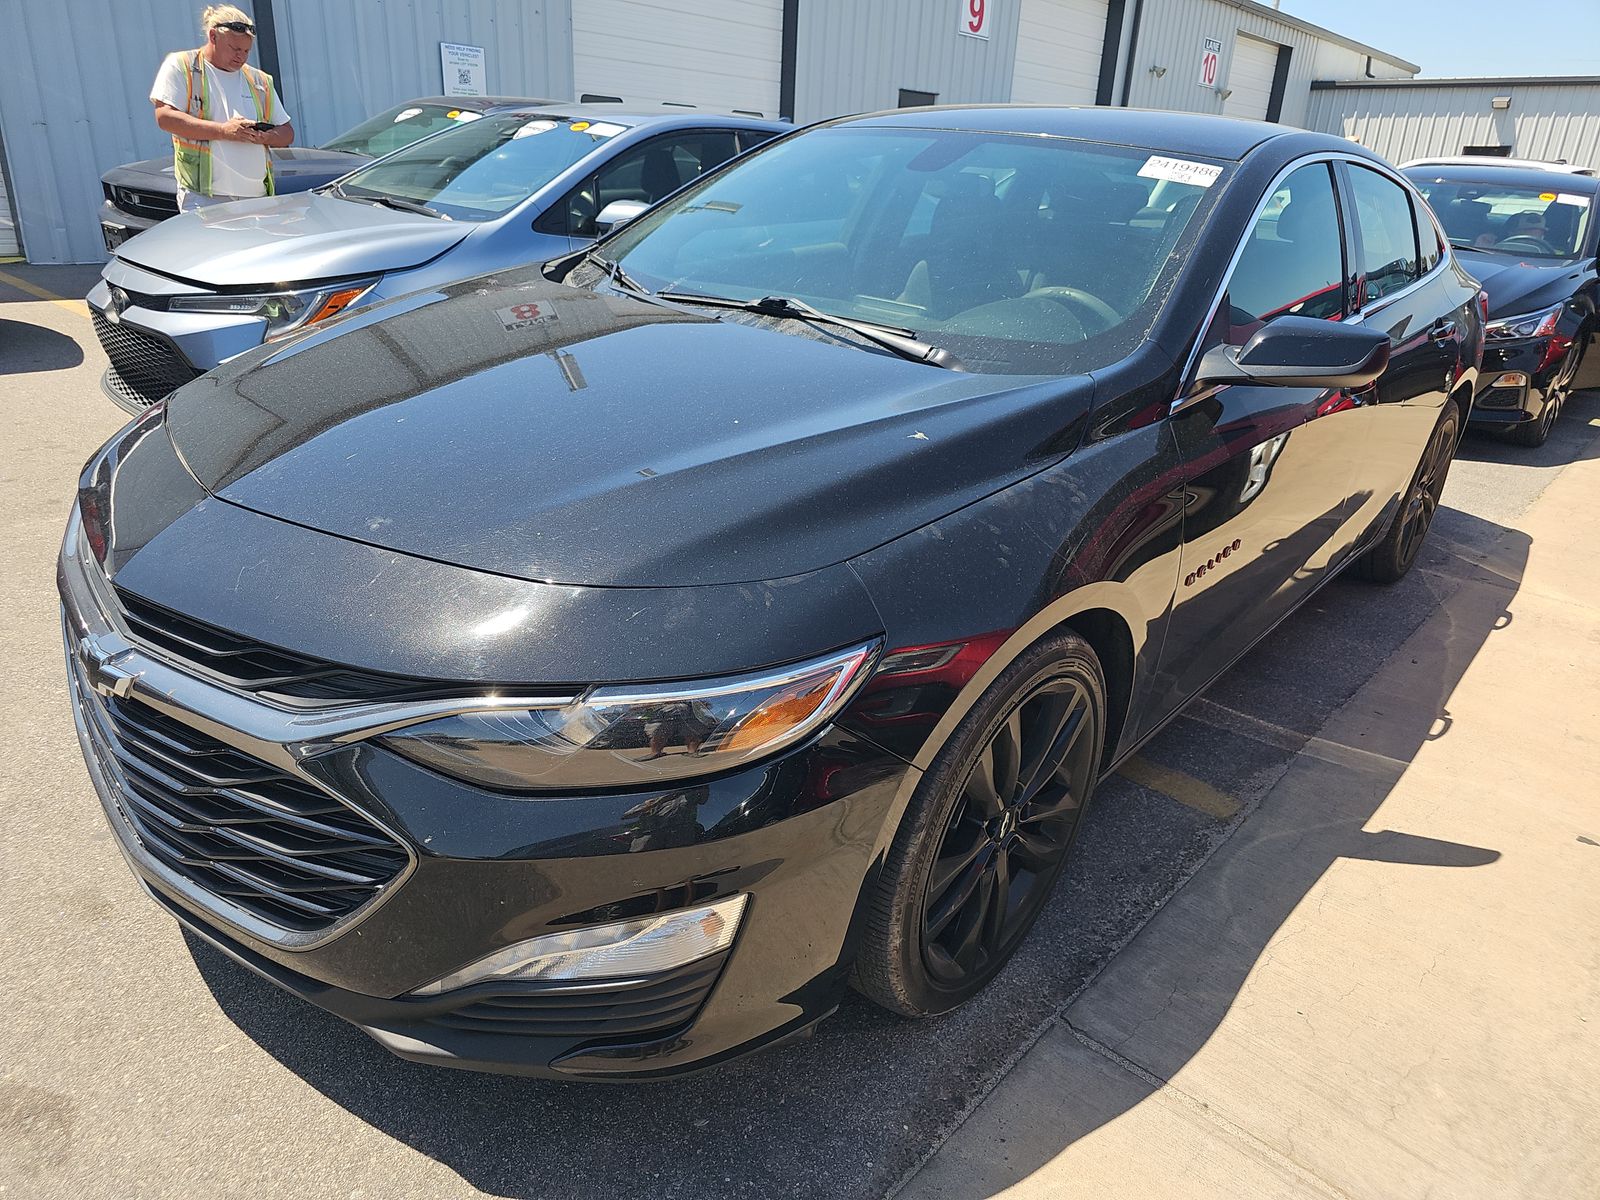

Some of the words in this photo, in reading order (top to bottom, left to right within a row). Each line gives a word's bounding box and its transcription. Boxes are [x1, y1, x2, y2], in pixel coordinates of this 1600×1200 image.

[968, 0, 985, 33] 9
[1205, 38, 1220, 52] LANE
[1203, 53, 1217, 84] 10
[1149, 159, 1219, 178] 2419486
